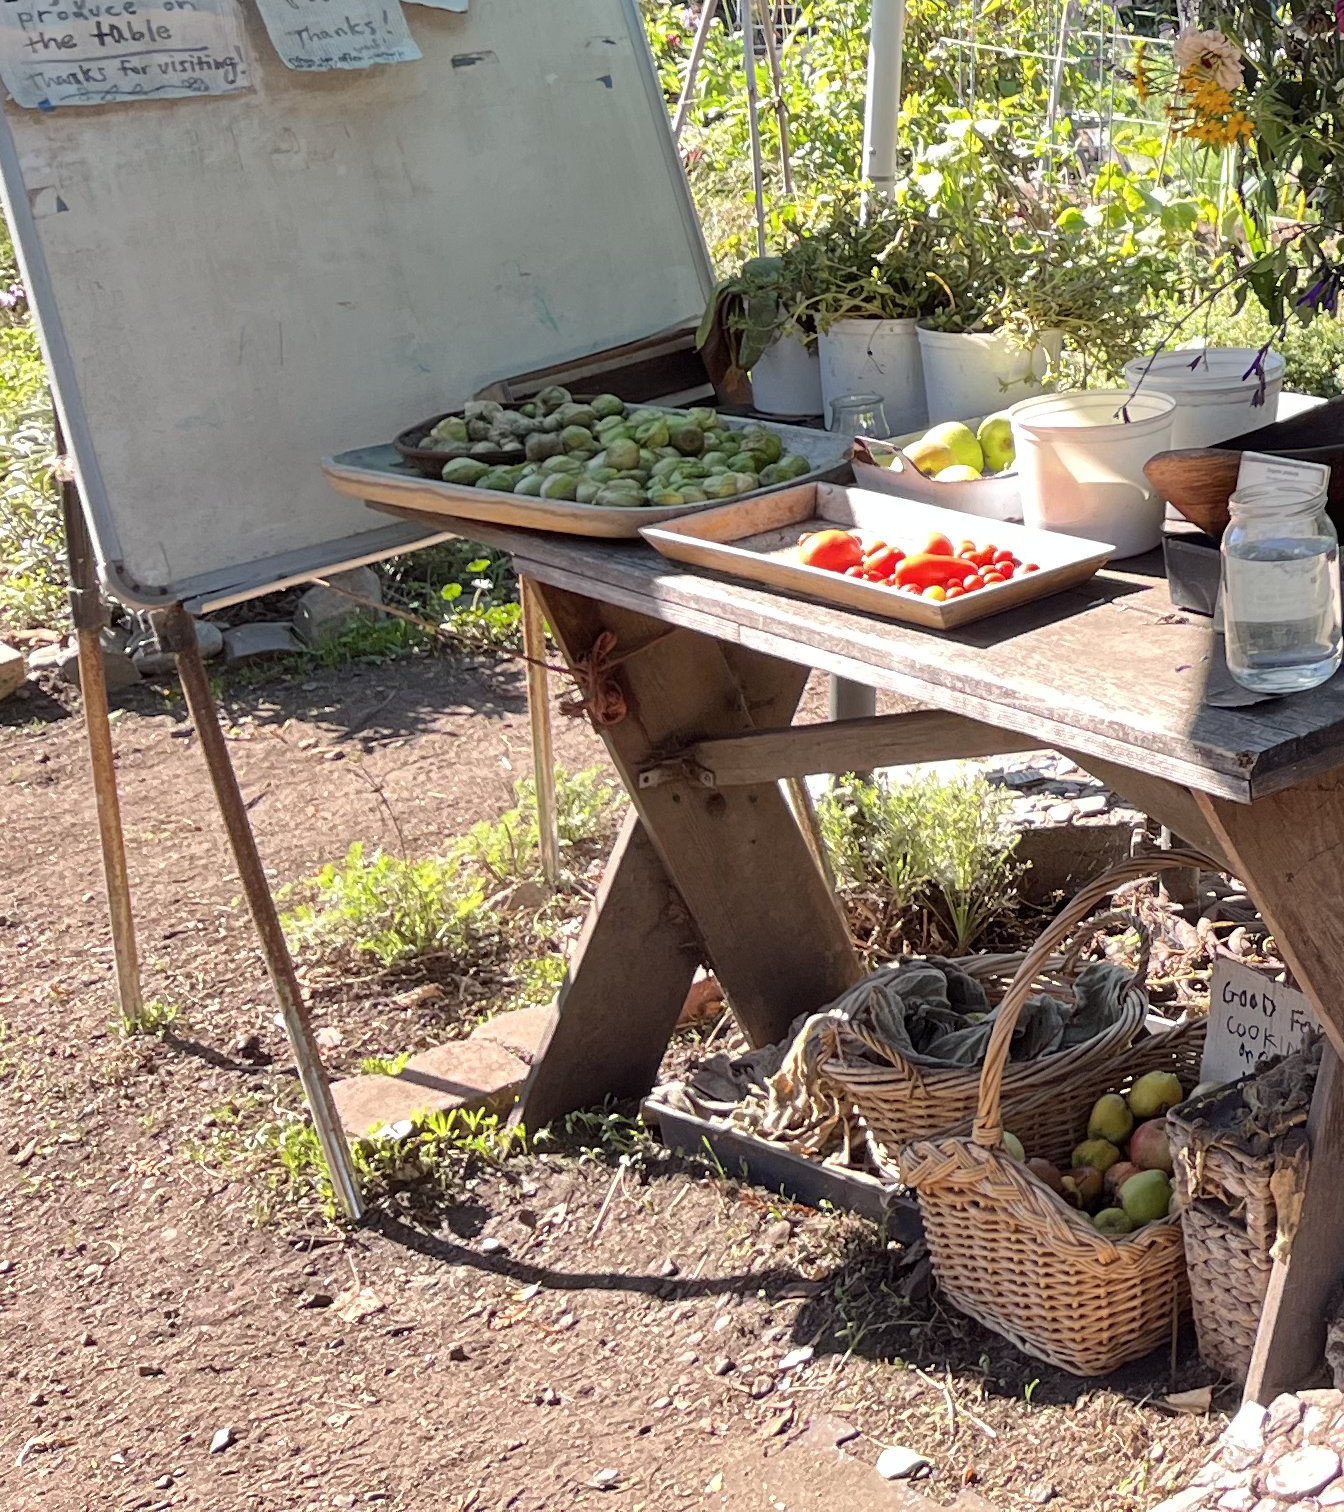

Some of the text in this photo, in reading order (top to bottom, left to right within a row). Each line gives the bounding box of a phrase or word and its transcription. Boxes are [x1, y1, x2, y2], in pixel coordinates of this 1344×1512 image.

[16, 0, 137, 31] produce
[23, 18, 173, 54] the table
[27, 64, 107, 89] Thanks
[1222, 980, 1276, 1018] GOOD
